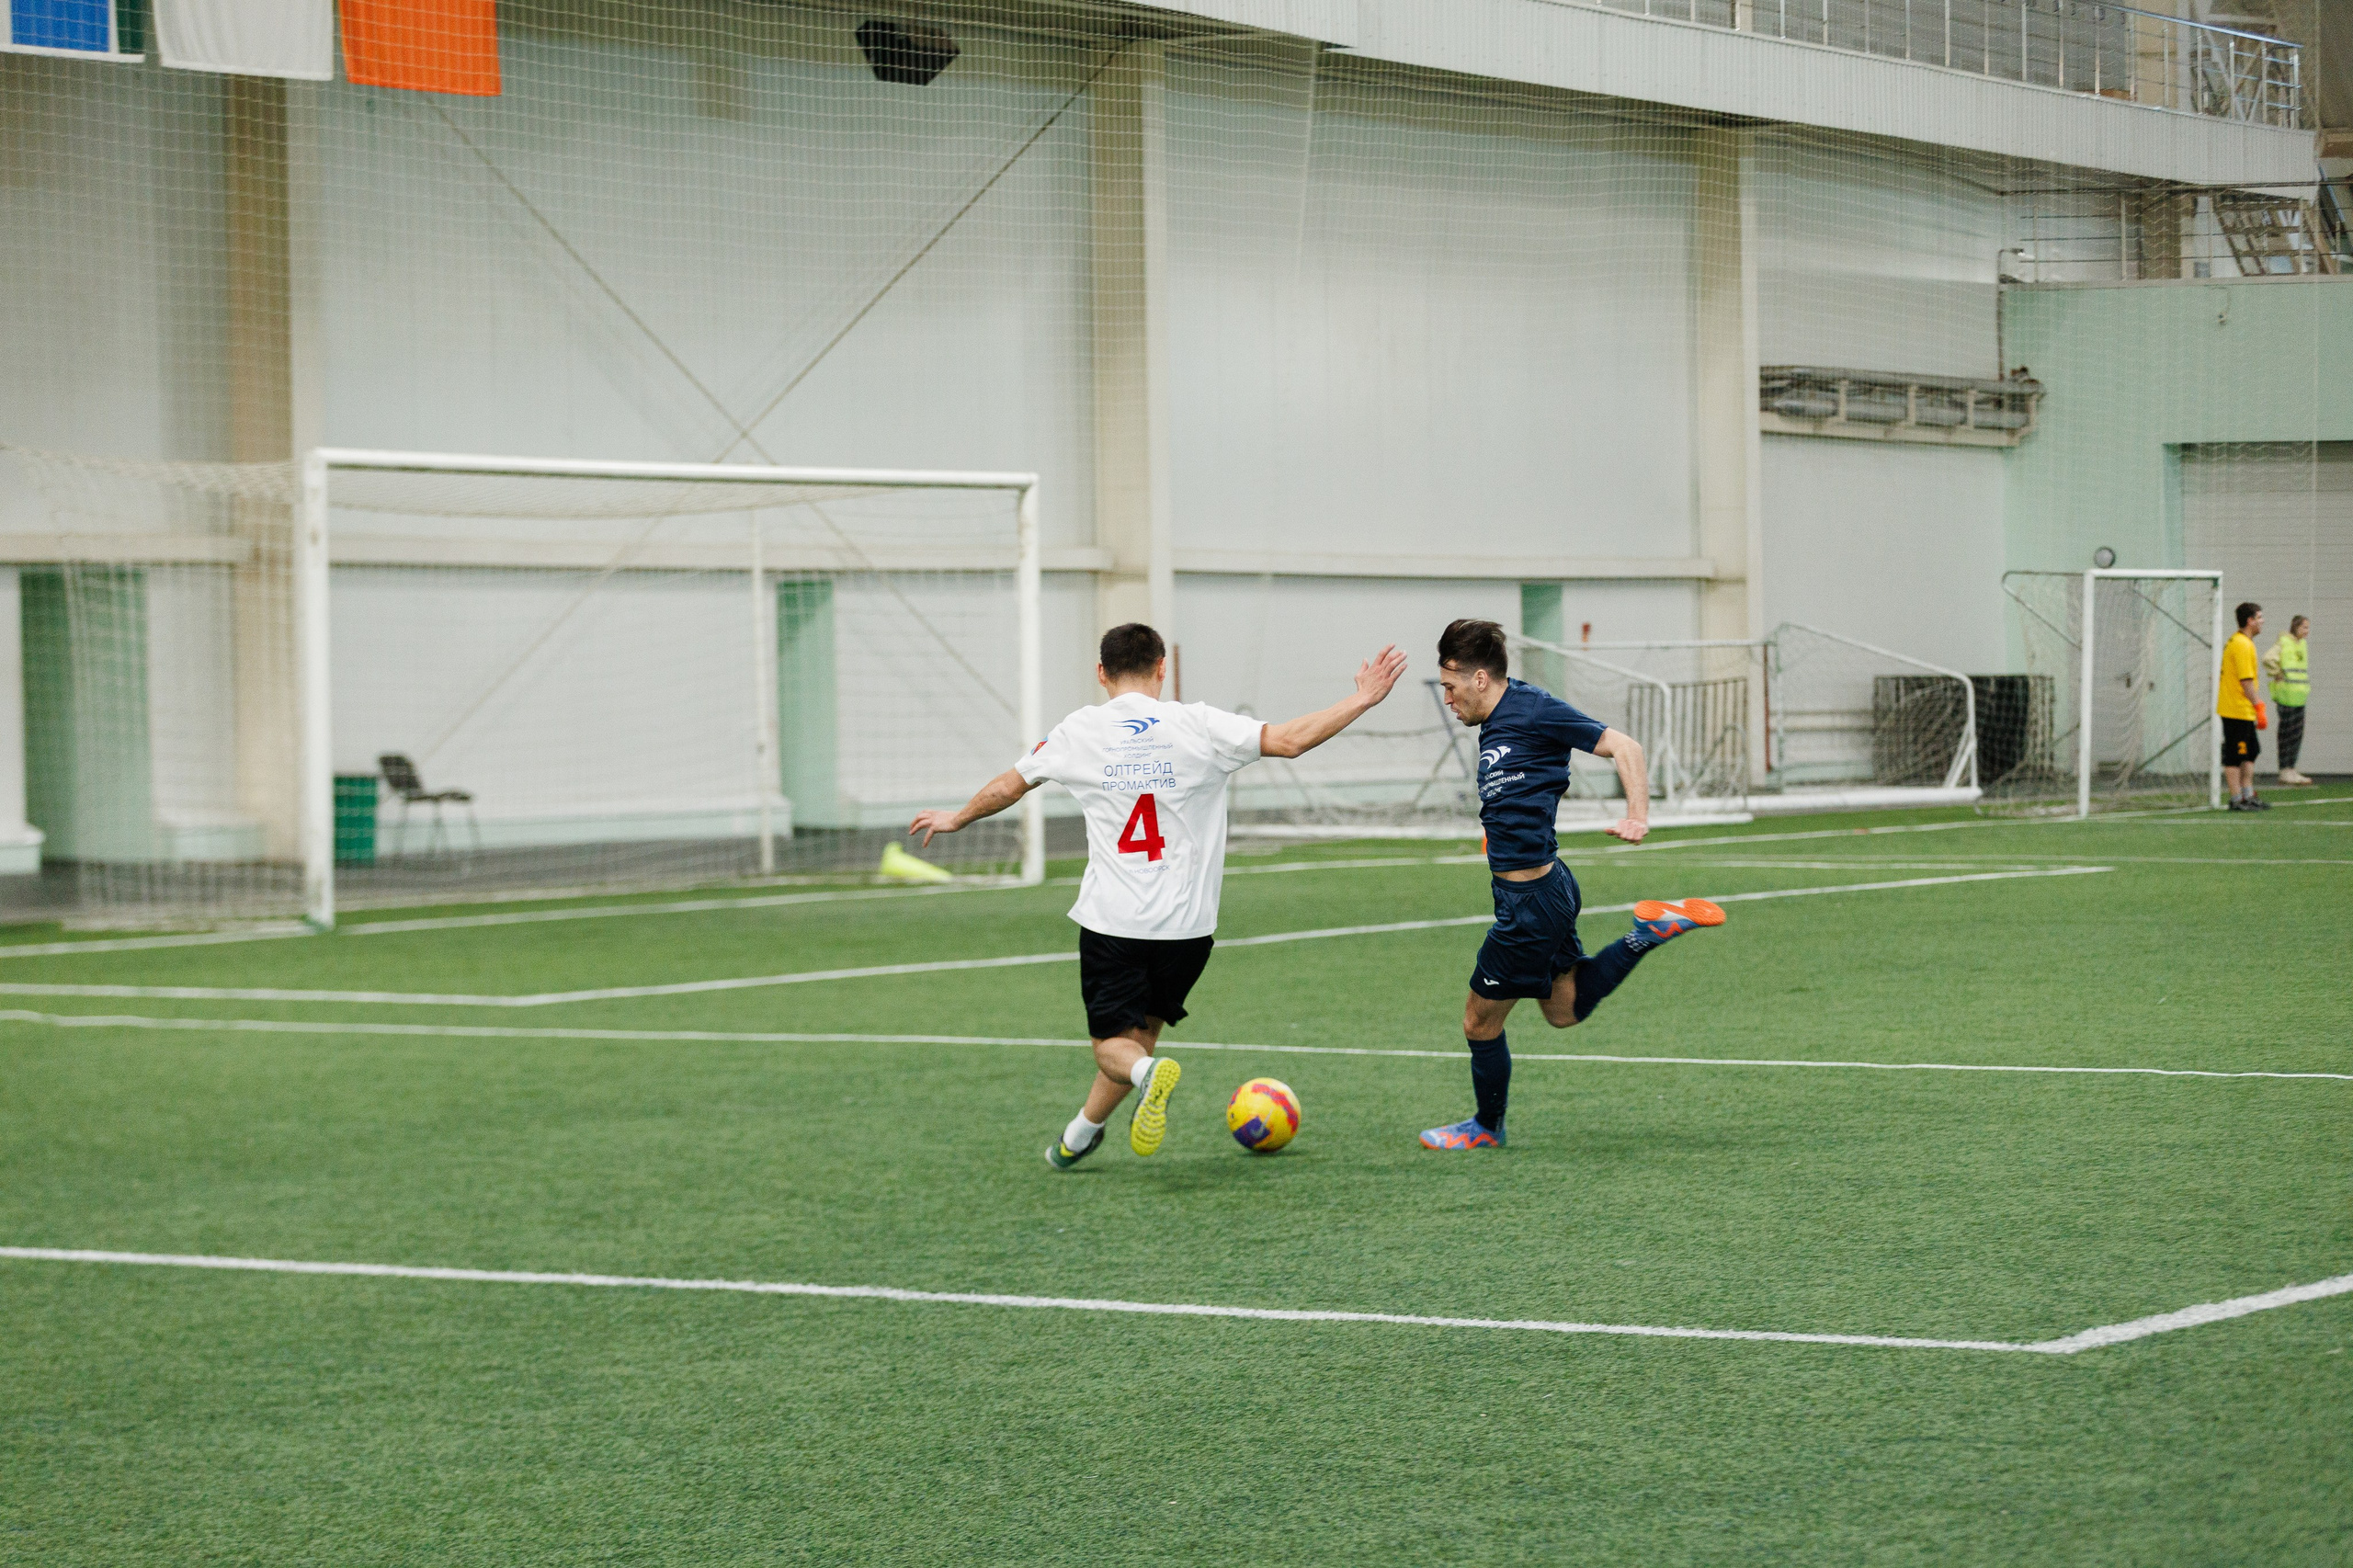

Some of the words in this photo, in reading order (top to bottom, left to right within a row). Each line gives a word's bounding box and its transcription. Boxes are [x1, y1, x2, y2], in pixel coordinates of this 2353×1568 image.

[1104, 760, 1174, 777] ОЛТРЕЙД
[1101, 778, 1176, 791] ПРОМАКТИВ
[1117, 792, 1166, 862] 4
